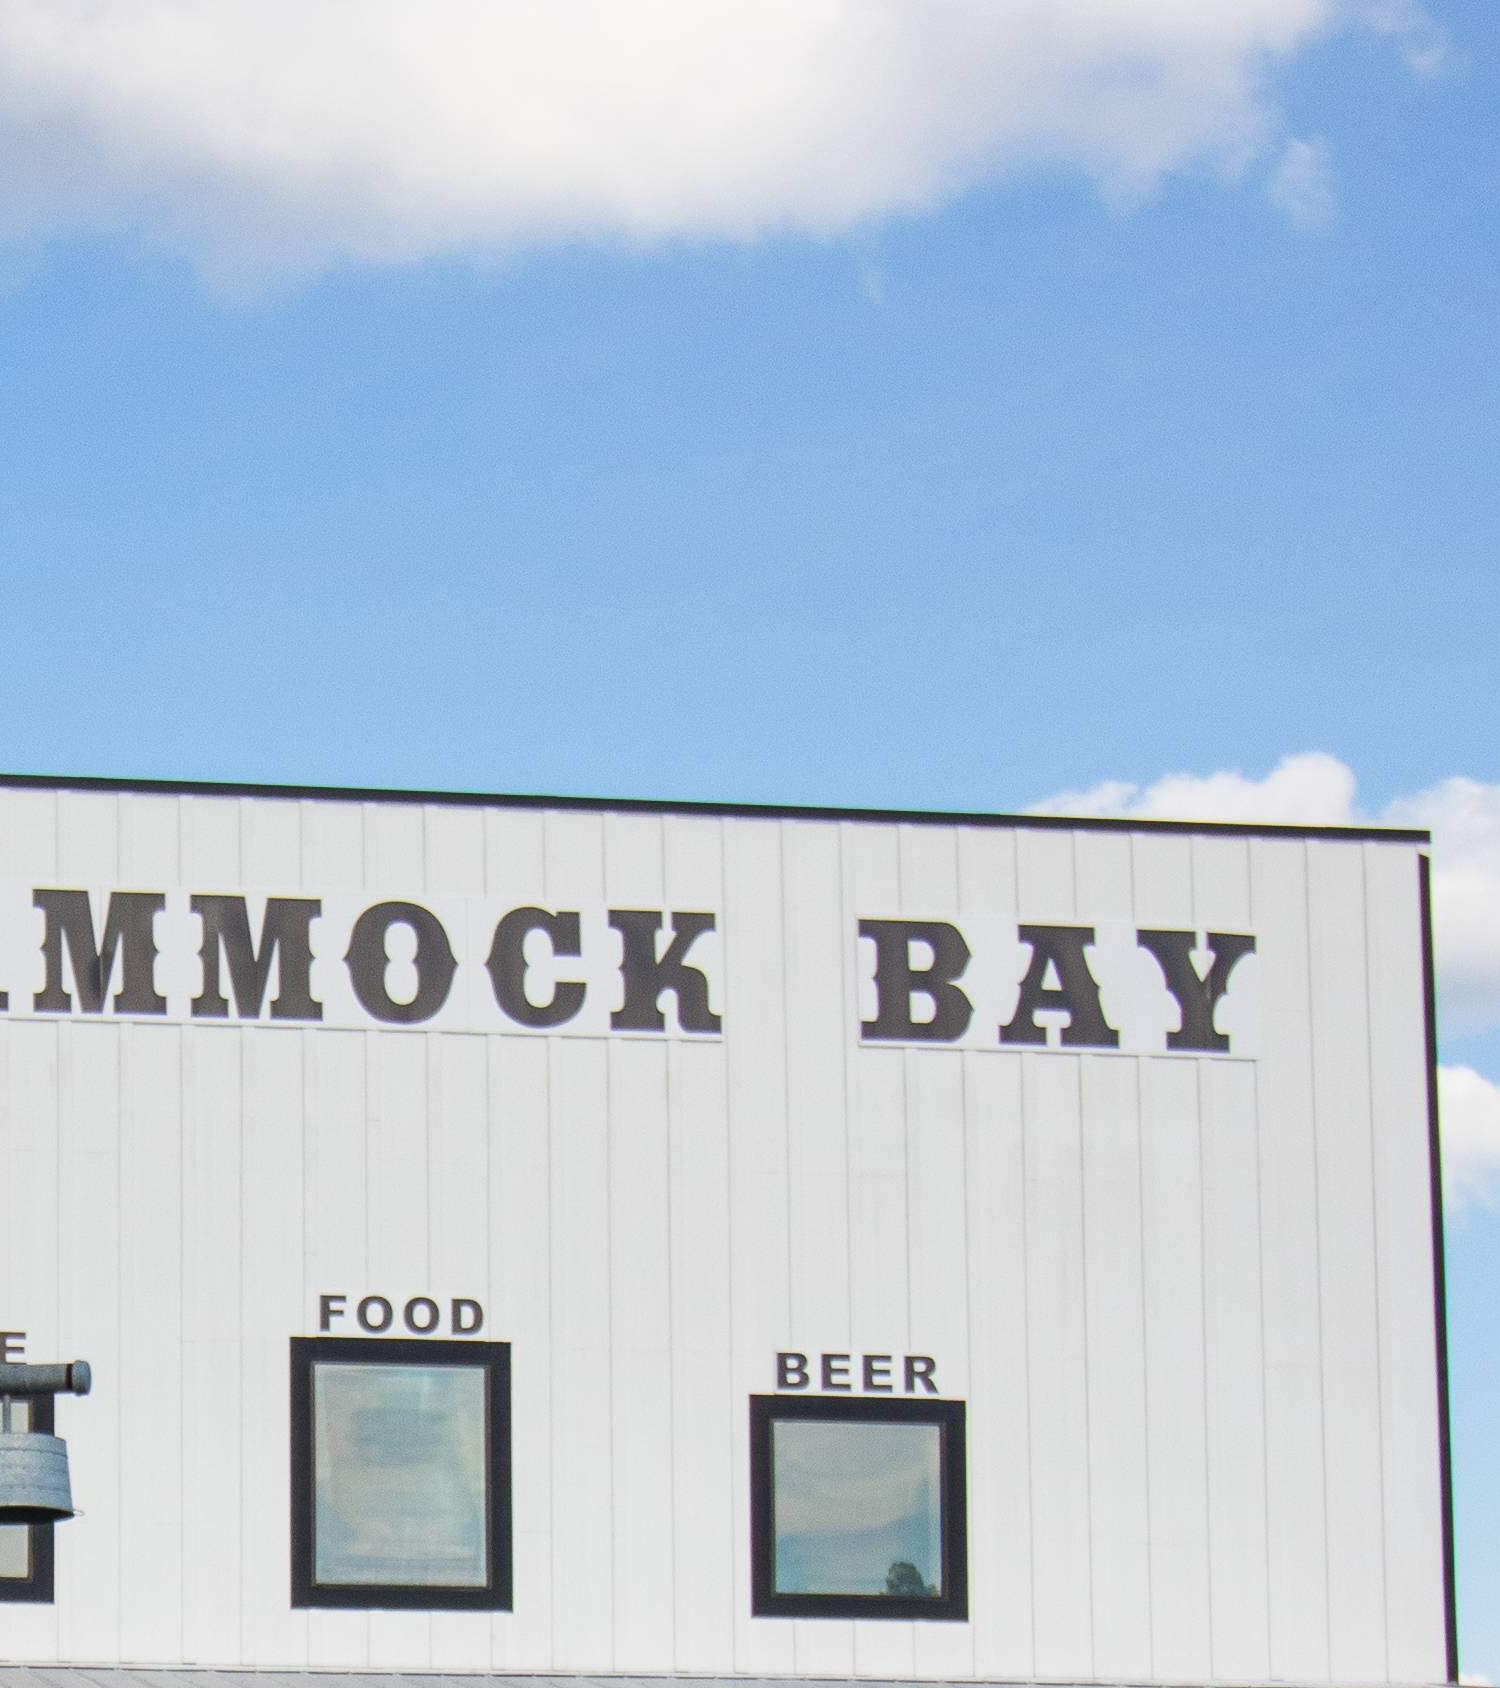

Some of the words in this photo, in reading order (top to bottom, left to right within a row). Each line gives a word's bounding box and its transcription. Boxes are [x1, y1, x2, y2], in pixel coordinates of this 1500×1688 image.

[858, 919, 1256, 1051] BAY
[319, 1295, 484, 1335] FOOD
[777, 1352, 938, 1393] BEER
